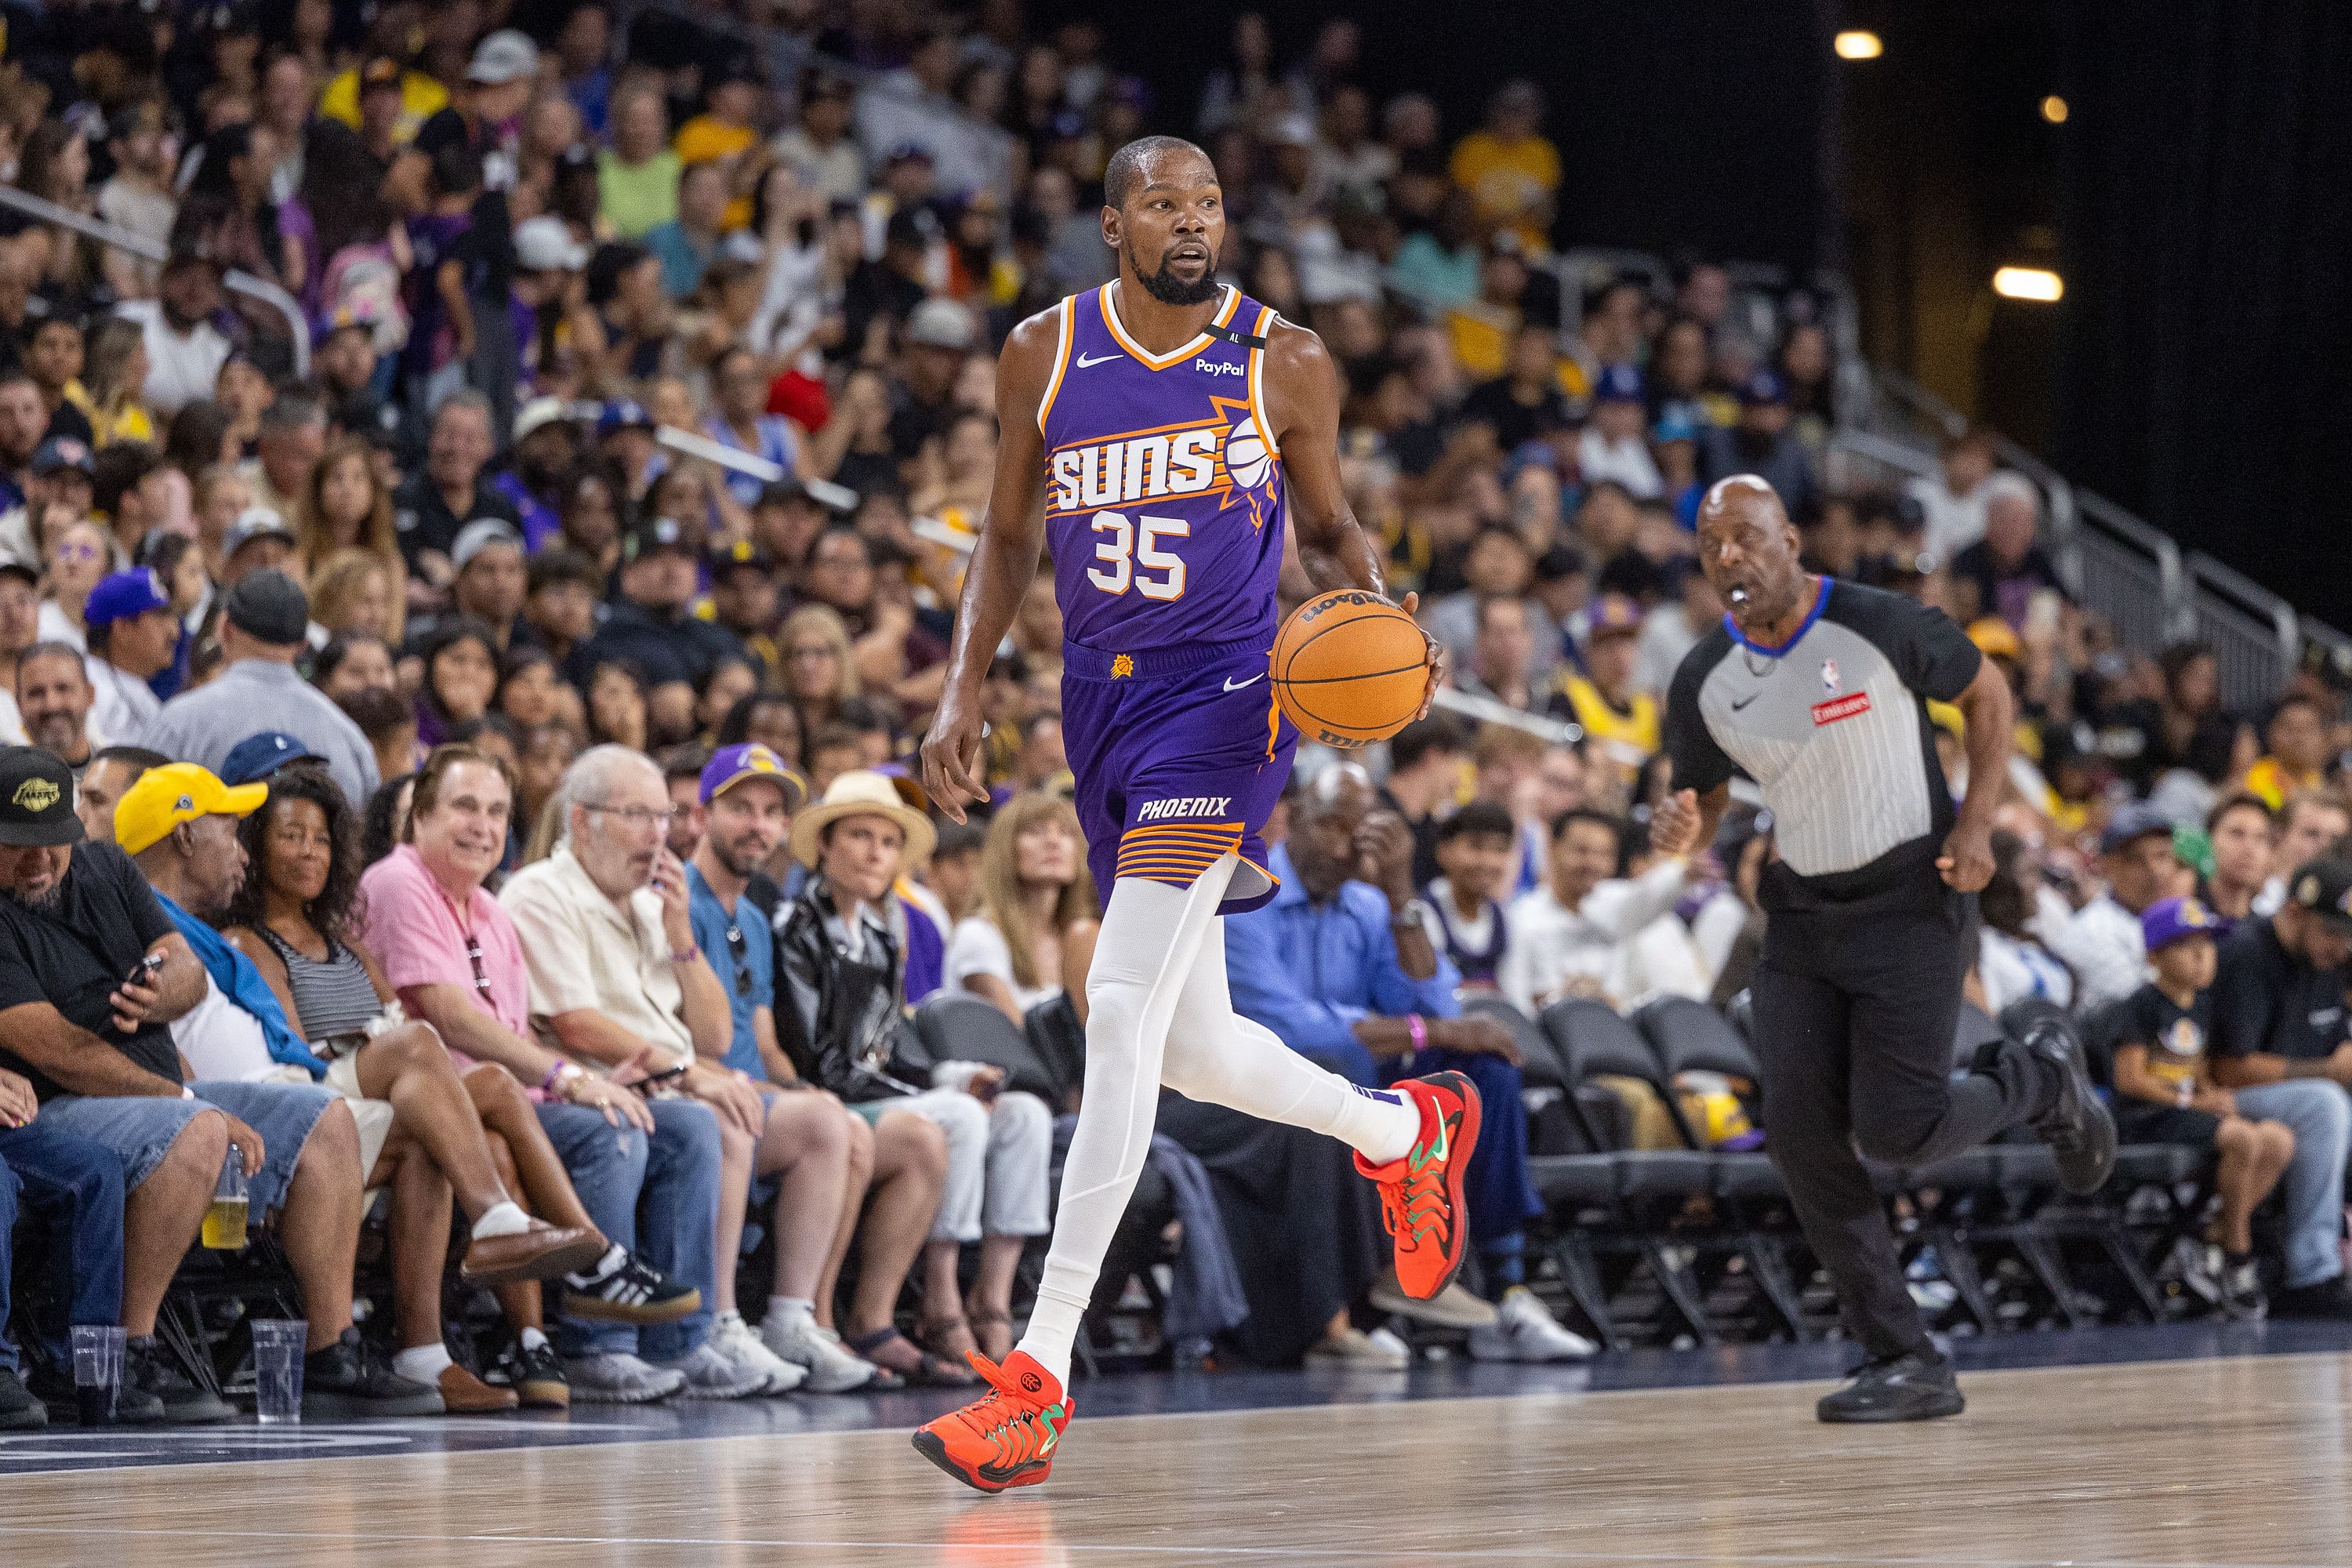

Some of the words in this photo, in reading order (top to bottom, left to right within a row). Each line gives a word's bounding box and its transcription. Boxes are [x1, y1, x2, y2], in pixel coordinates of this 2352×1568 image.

[1229, 332, 1239, 343] AL
[1196, 358, 1244, 376] PayPal
[1054, 430, 1216, 510] SUNS
[1087, 510, 1190, 601] 35
[1137, 797, 1232, 822] PHOENIX
